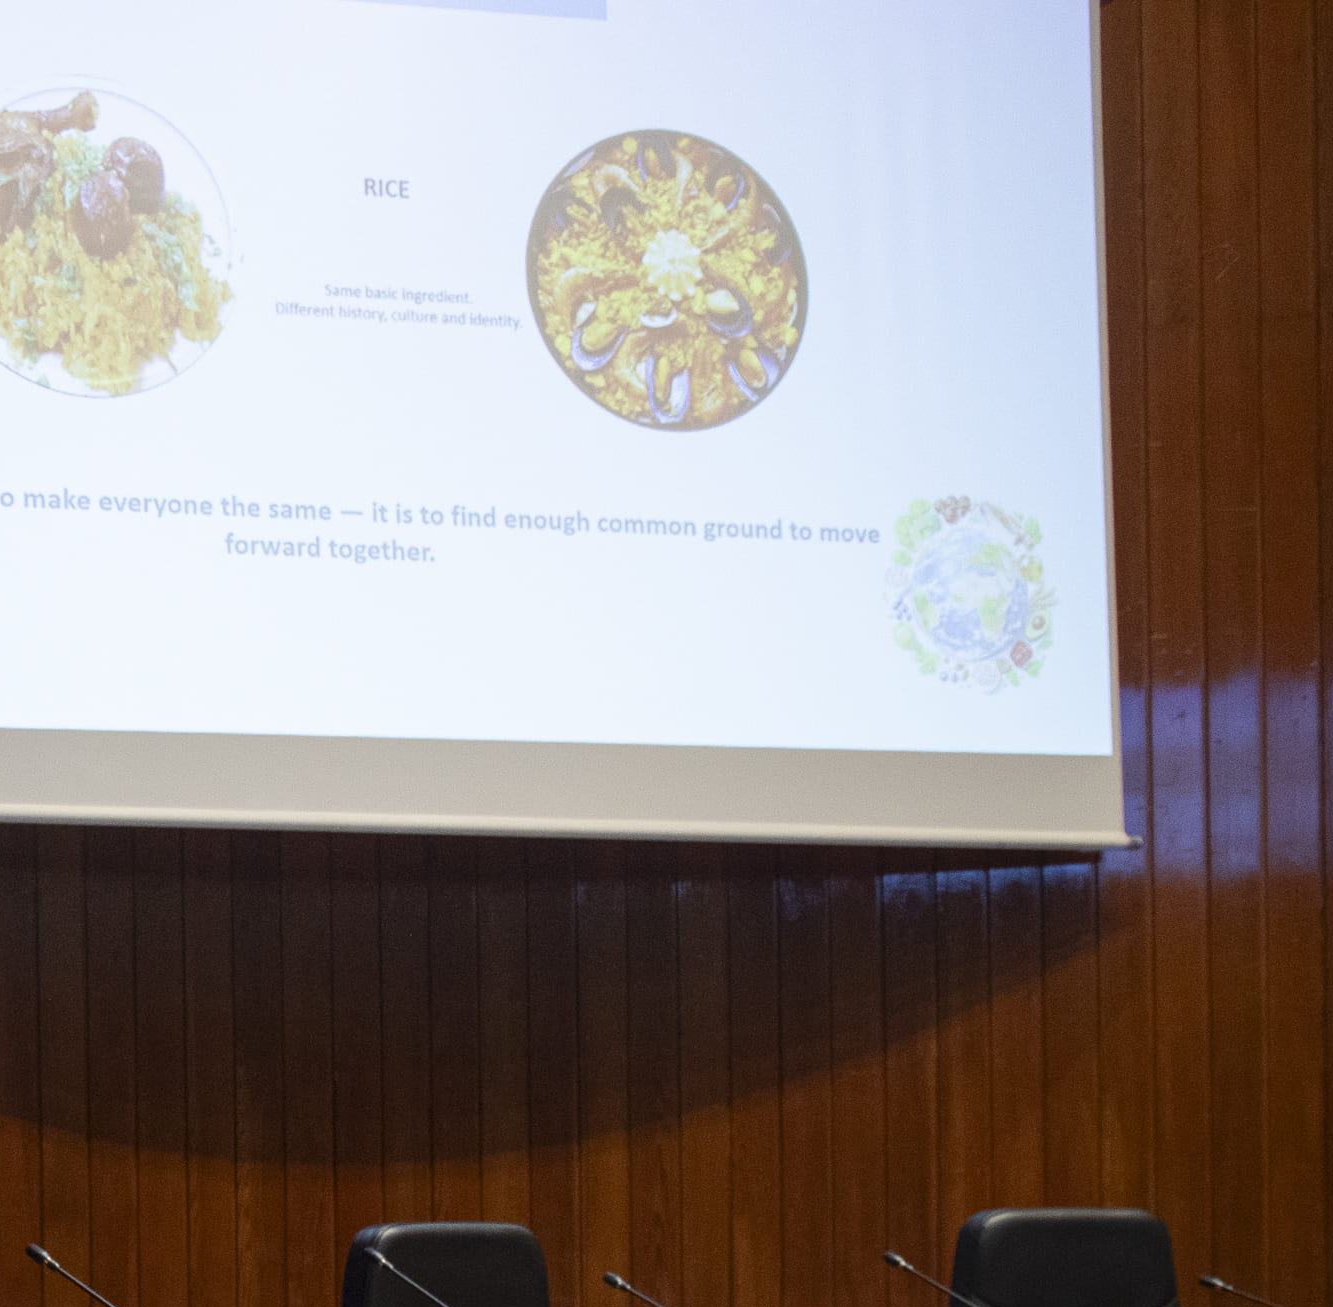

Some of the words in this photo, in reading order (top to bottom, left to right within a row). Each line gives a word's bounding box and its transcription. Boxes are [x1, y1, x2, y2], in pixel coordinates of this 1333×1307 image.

[363, 177, 410, 199] RICE
[324, 284, 362, 298] Same
[365, 285, 397, 300] basic
[402, 288, 473, 305] ingredient.
[275, 302, 335, 317] Different
[338, 305, 388, 323] history,
[391, 310, 438, 324] culture
[441, 312, 466, 326] and
[469, 313, 523, 331] identity.
[23, 487, 91, 511] make
[98, 495, 213, 518] everyone
[220, 494, 261, 518] the
[268, 502, 332, 521] same
[372, 501, 389, 524] it
[395, 502, 414, 525] is
[419, 506, 445, 526] to
[451, 504, 497, 528] find
[503, 509, 590, 536] enough
[597, 517, 697, 537] common
[703, 518, 783, 542] ground
[789, 521, 813, 541] to
[819, 526, 881, 544] move
[224, 531, 321, 558] forward
[328, 538, 436, 565] together.
